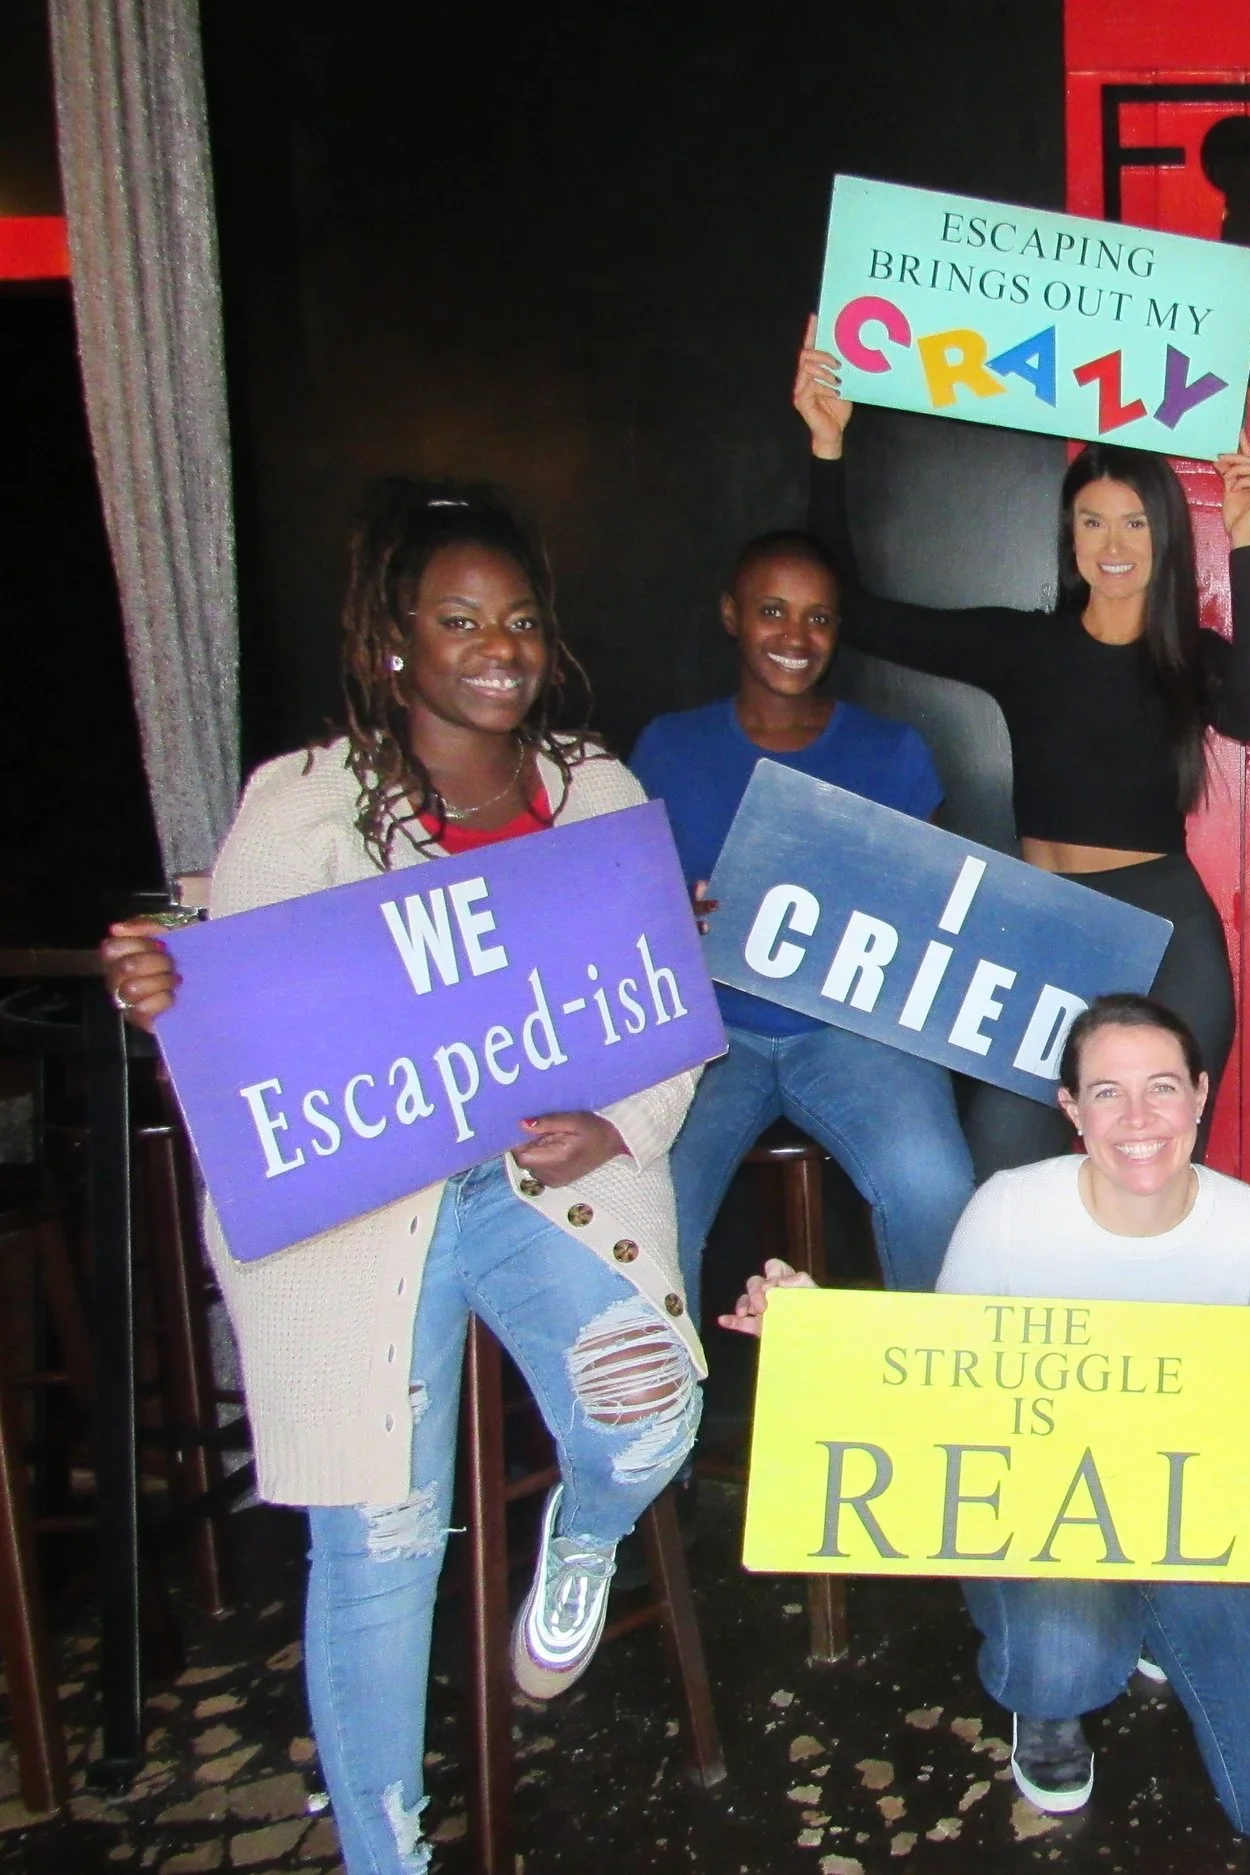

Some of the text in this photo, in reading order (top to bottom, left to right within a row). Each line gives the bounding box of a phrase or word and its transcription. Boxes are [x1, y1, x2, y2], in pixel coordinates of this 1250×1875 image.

[942, 212, 1155, 278] ESCAPING
[868, 249, 1214, 336] BRINGS OUT MY
[834, 295, 1229, 435] CRAZY
[381, 877, 508, 996] WE
[939, 855, 987, 934] I
[744, 884, 1089, 1080] CRIED
[240, 934, 687, 1179] Escaped-ish
[984, 1304, 1092, 1346] THE
[882, 1346, 1184, 1395] STRUGGLE
[1011, 1396, 1056, 1437] IS
[806, 1439, 1237, 1567] REAL
